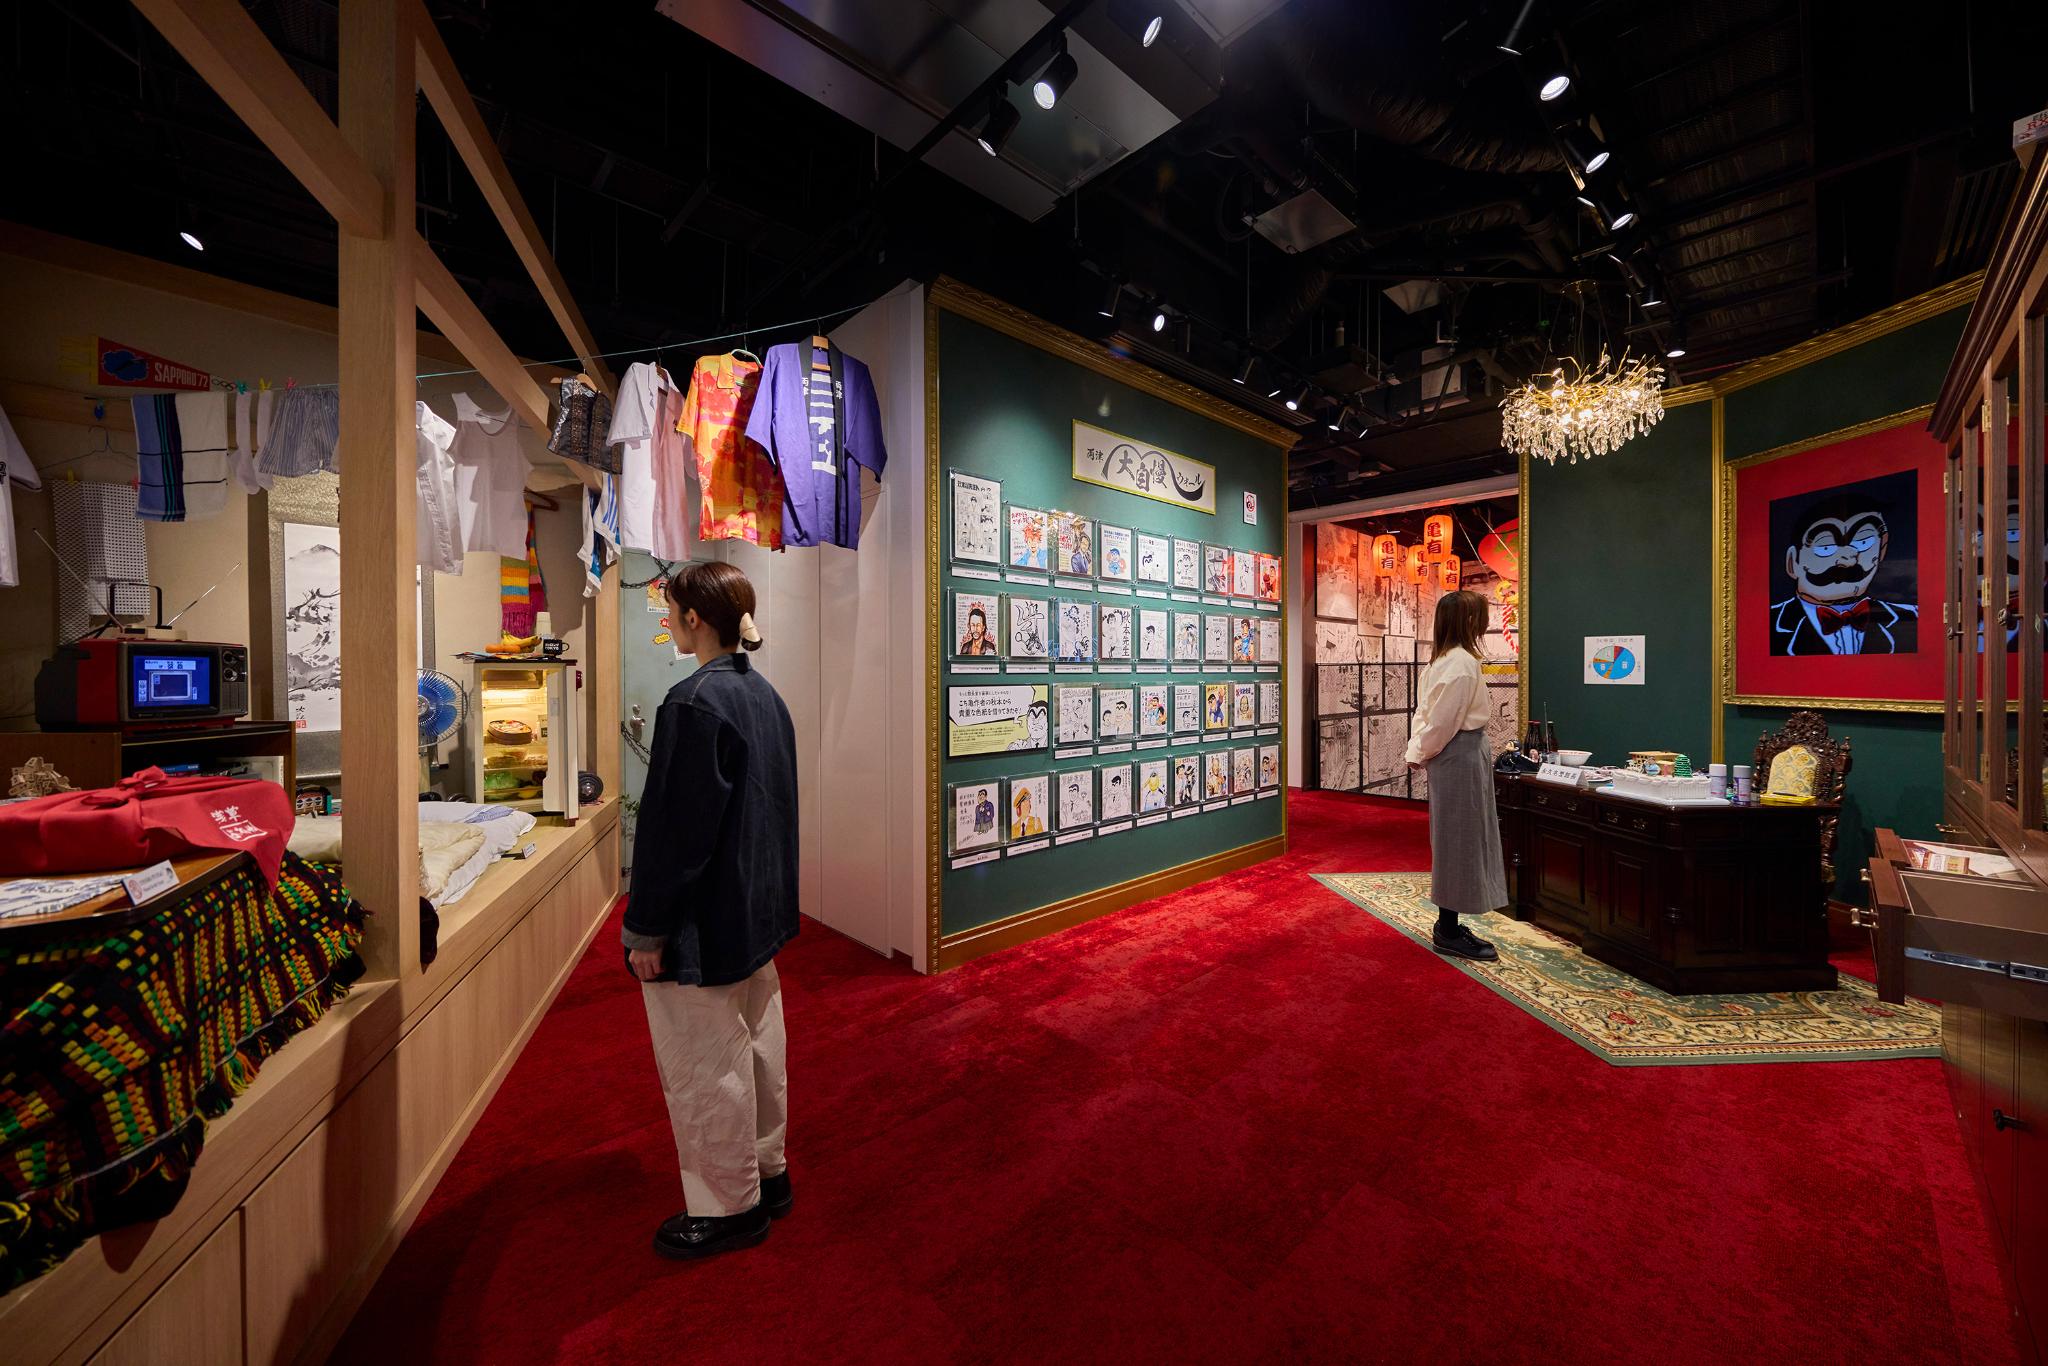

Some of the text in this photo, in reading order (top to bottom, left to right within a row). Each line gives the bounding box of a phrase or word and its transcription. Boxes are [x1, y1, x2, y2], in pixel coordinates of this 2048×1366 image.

[1427, 521, 1442, 554] 亀有
[1381, 540, 1394, 569] 亀有
[1445, 559, 1458, 584] 亀有
